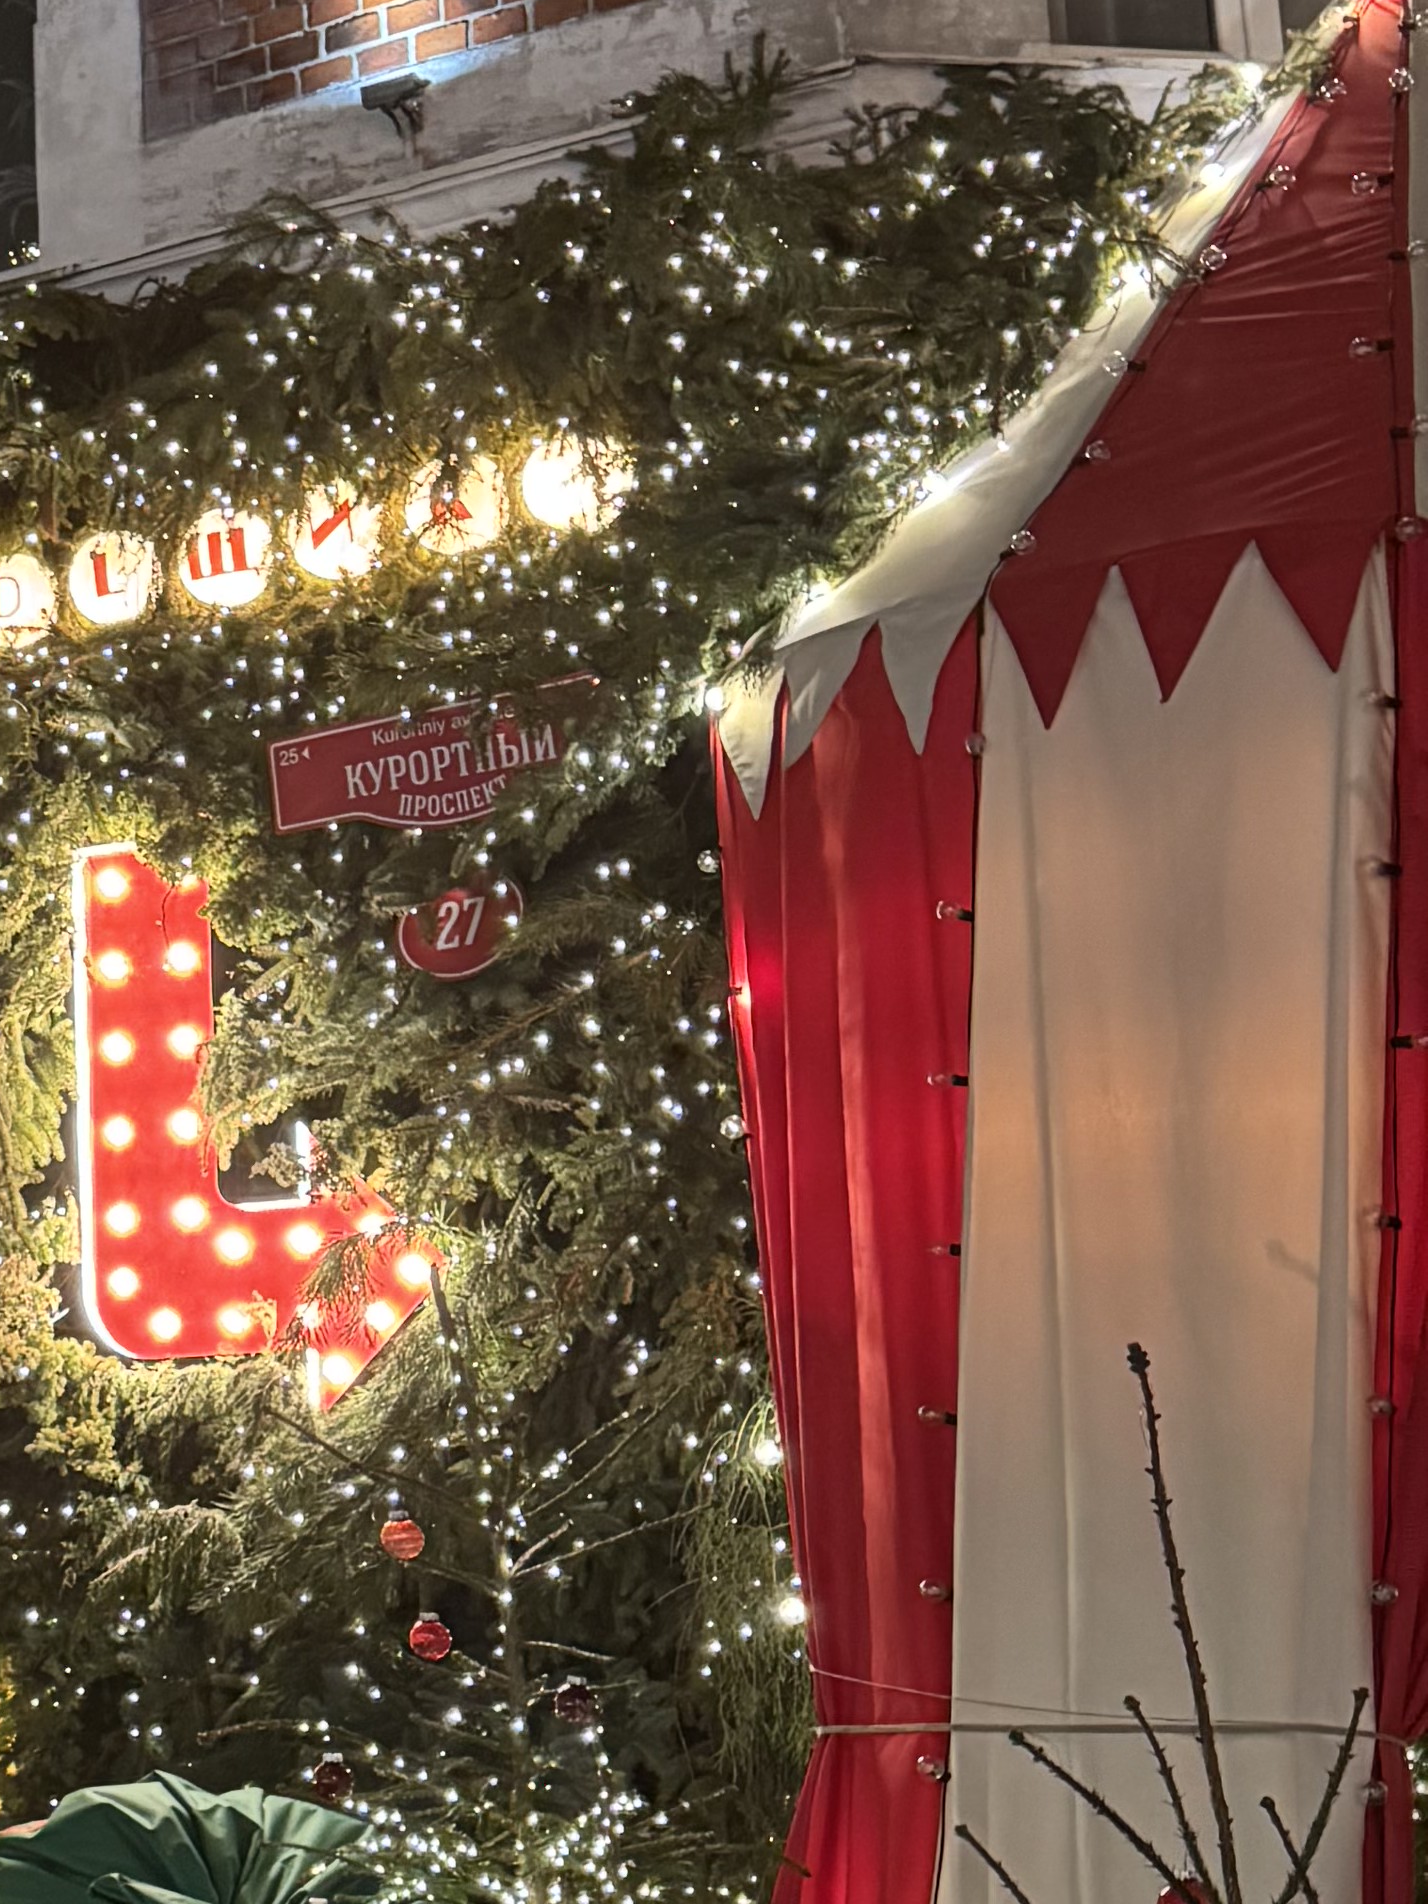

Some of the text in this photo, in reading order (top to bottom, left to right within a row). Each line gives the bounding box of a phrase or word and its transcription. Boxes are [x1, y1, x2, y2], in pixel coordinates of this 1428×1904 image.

[279, 748, 300, 767] 25
[398, 773, 506, 817] ПРОСПЕКТ
[436, 897, 485, 951] 27
